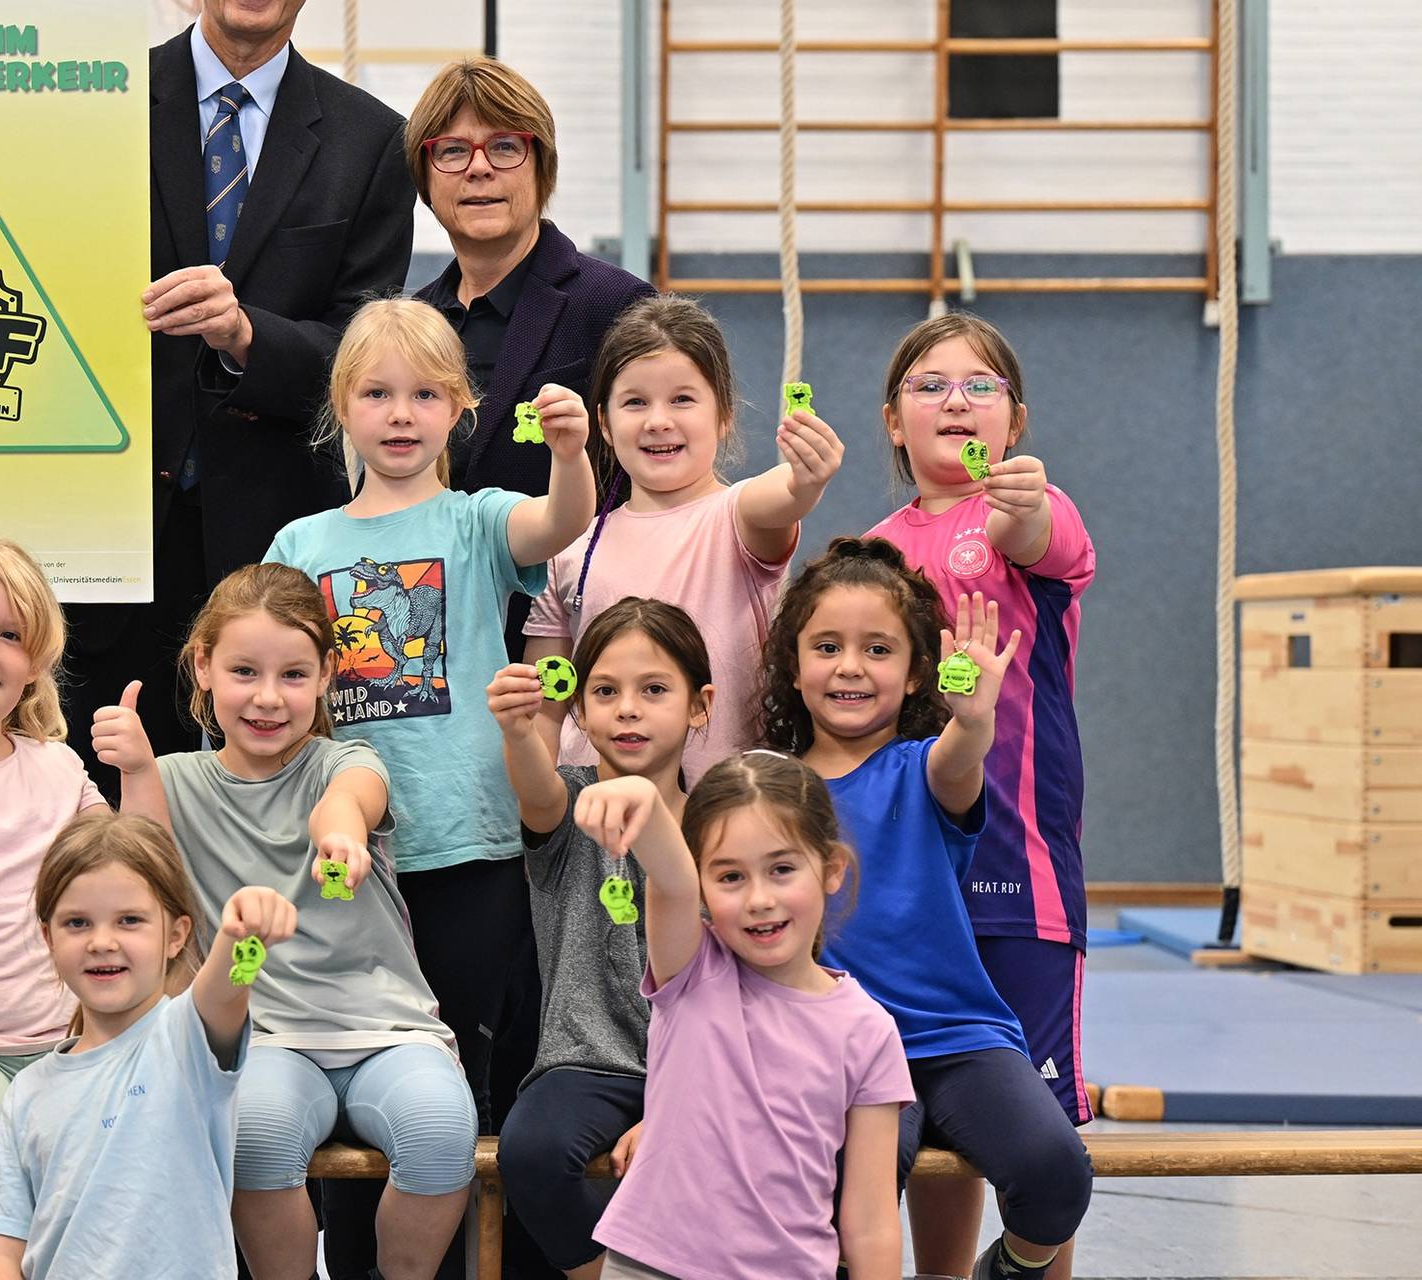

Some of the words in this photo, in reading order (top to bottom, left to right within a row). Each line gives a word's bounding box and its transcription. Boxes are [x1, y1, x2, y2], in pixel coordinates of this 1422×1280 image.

[330, 686, 368, 707] WILD
[346, 700, 393, 722] LAND
[972, 881, 1022, 894] HEAT.RDY
